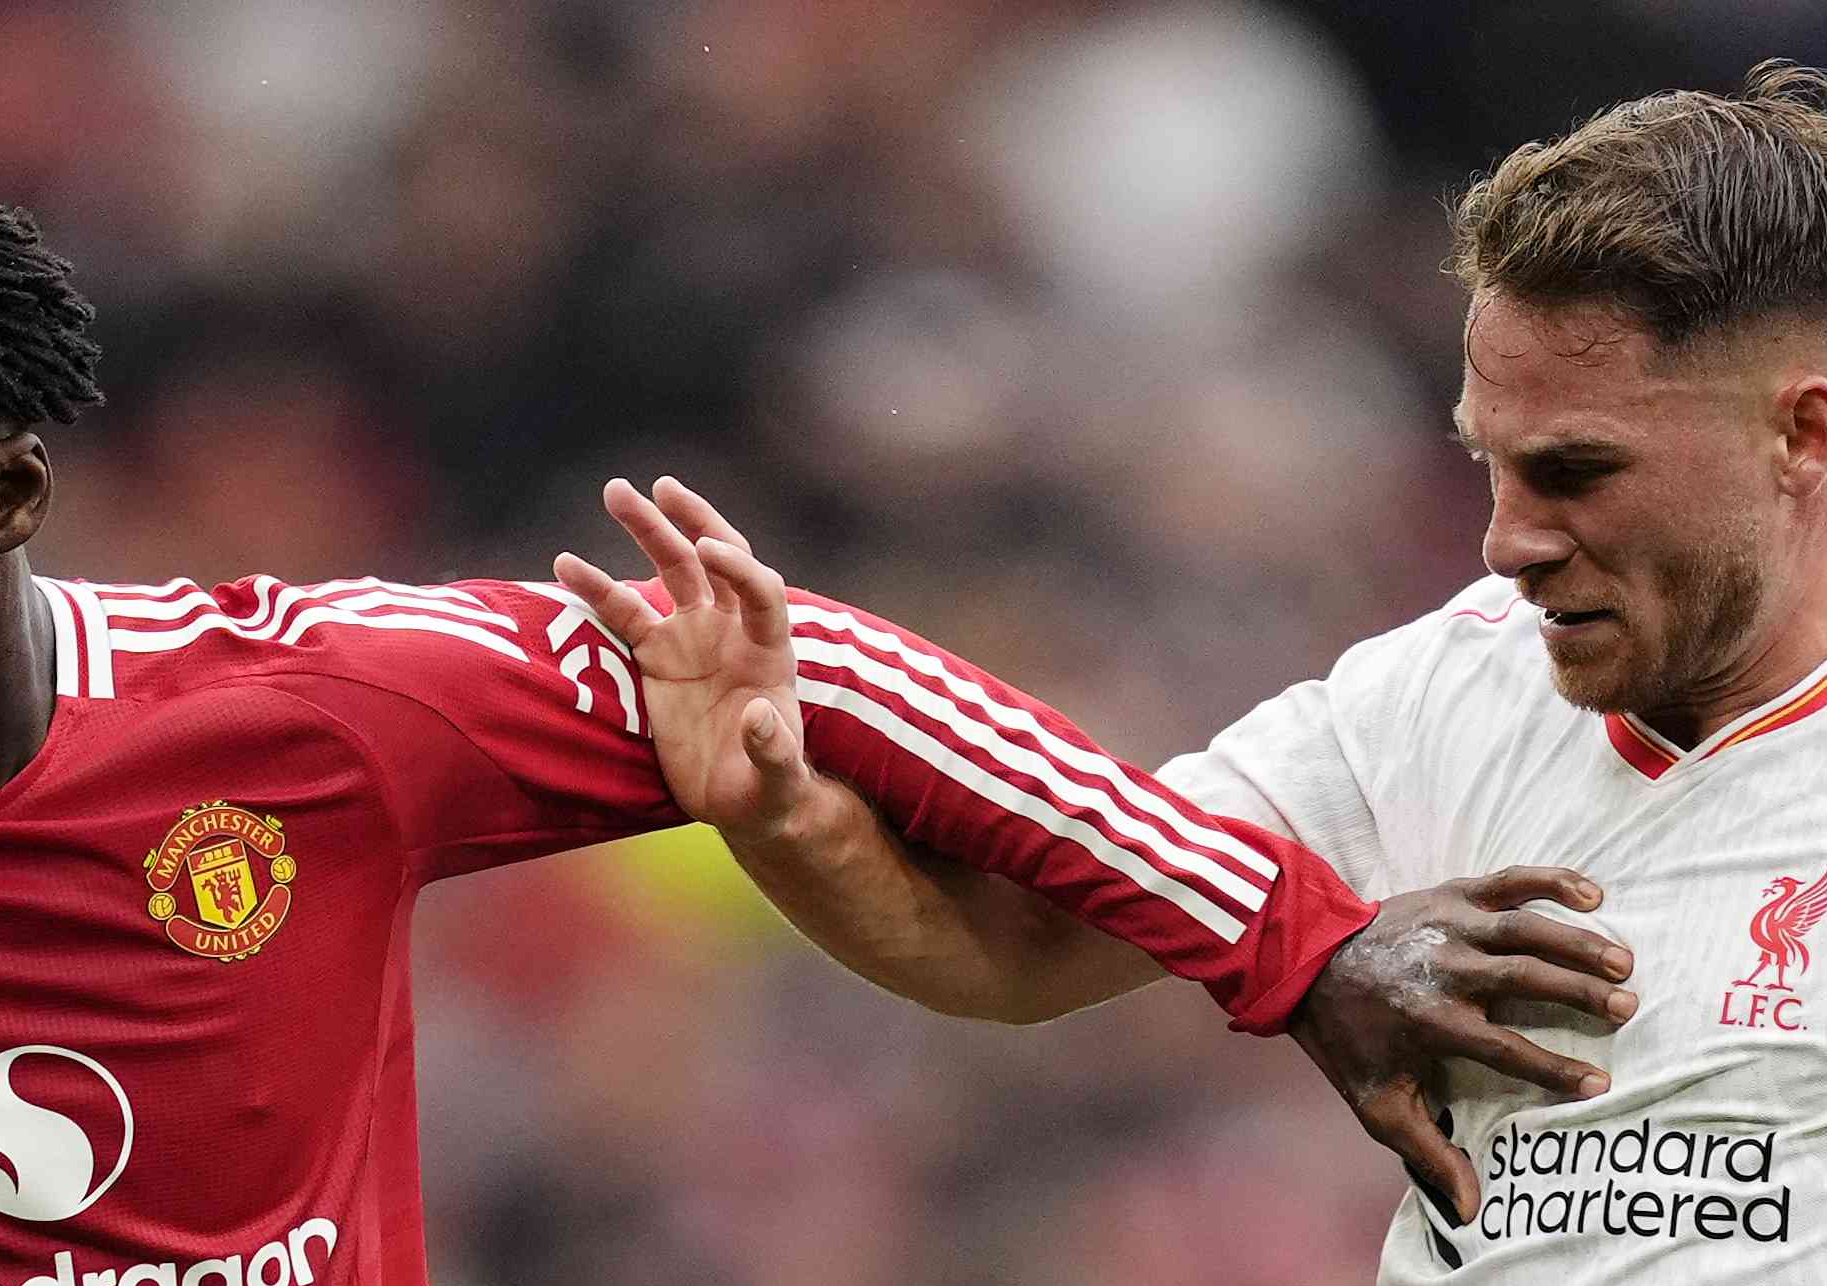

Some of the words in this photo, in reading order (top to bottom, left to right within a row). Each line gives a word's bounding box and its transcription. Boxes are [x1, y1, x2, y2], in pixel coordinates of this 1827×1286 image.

[157, 812, 275, 879] MANCHESTER
[195, 911, 275, 951] UNITED
[1719, 991, 1808, 1032] L.F.C.
[1489, 1118, 1778, 1184] standard
[1480, 1178, 1791, 1243] chartered
